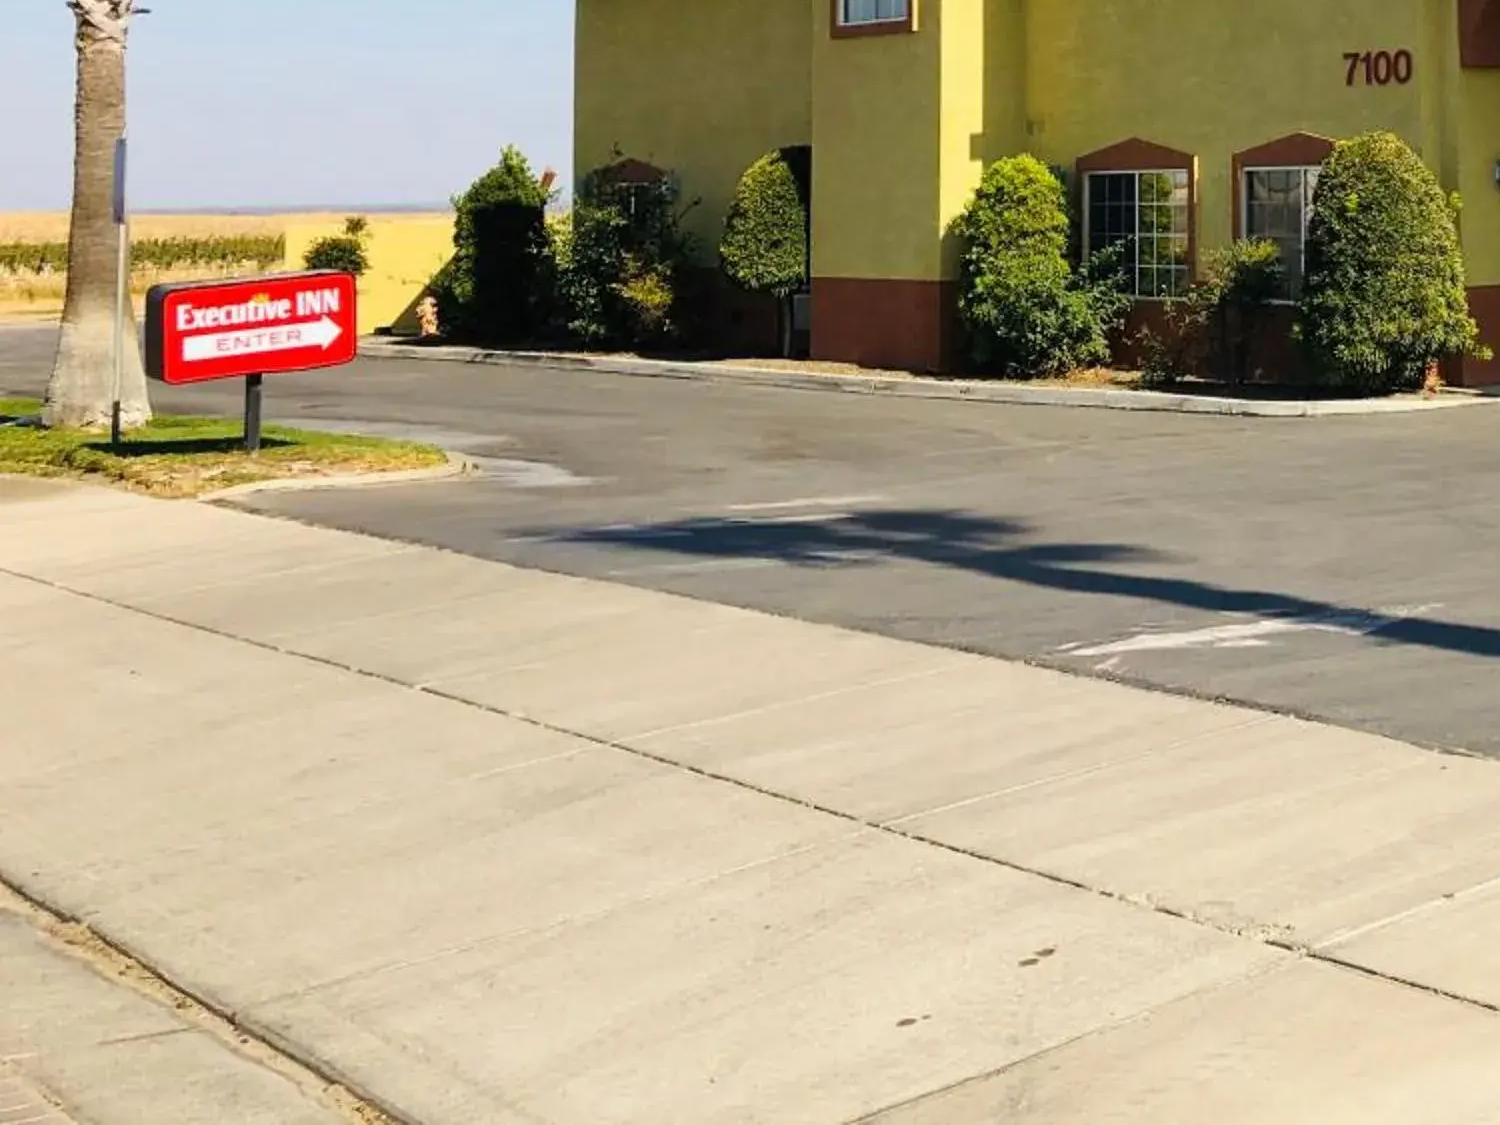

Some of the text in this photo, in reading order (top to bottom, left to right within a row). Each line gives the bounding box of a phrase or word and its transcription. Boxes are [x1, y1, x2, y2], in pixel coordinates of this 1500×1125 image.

[1343, 49, 1412, 86] 7100
[176, 288, 341, 331] Executive INN
[217, 330, 303, 352] ENTER
